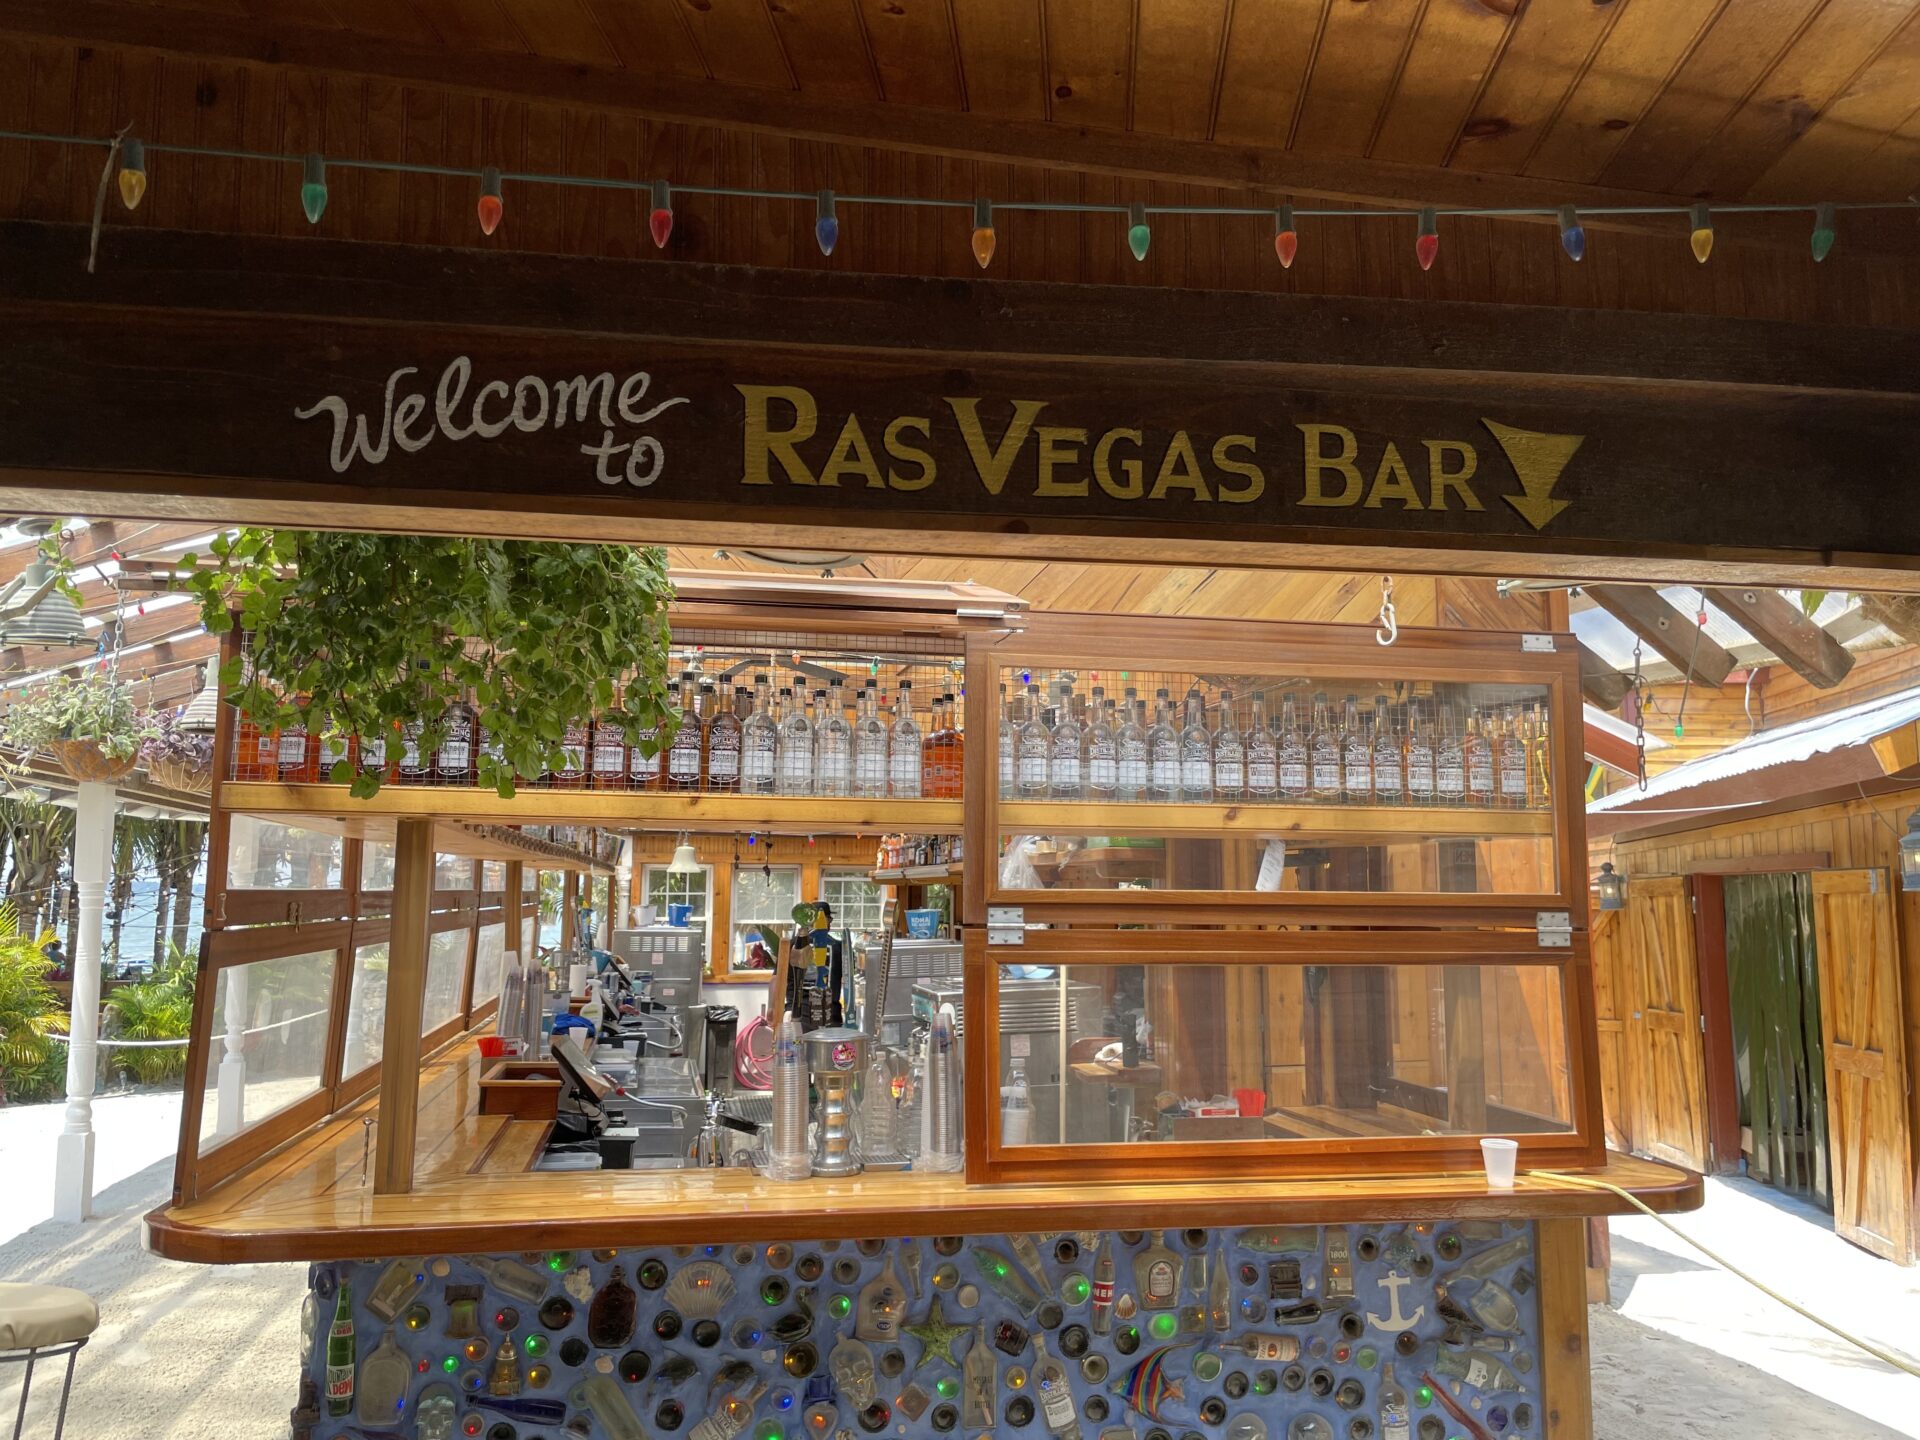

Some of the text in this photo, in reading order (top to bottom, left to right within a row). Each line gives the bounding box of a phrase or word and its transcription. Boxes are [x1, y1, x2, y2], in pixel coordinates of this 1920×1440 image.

[295, 355, 690, 473] Welcome
[580, 429, 665, 487] to
[1330, 1250, 1348, 1259] 1800
